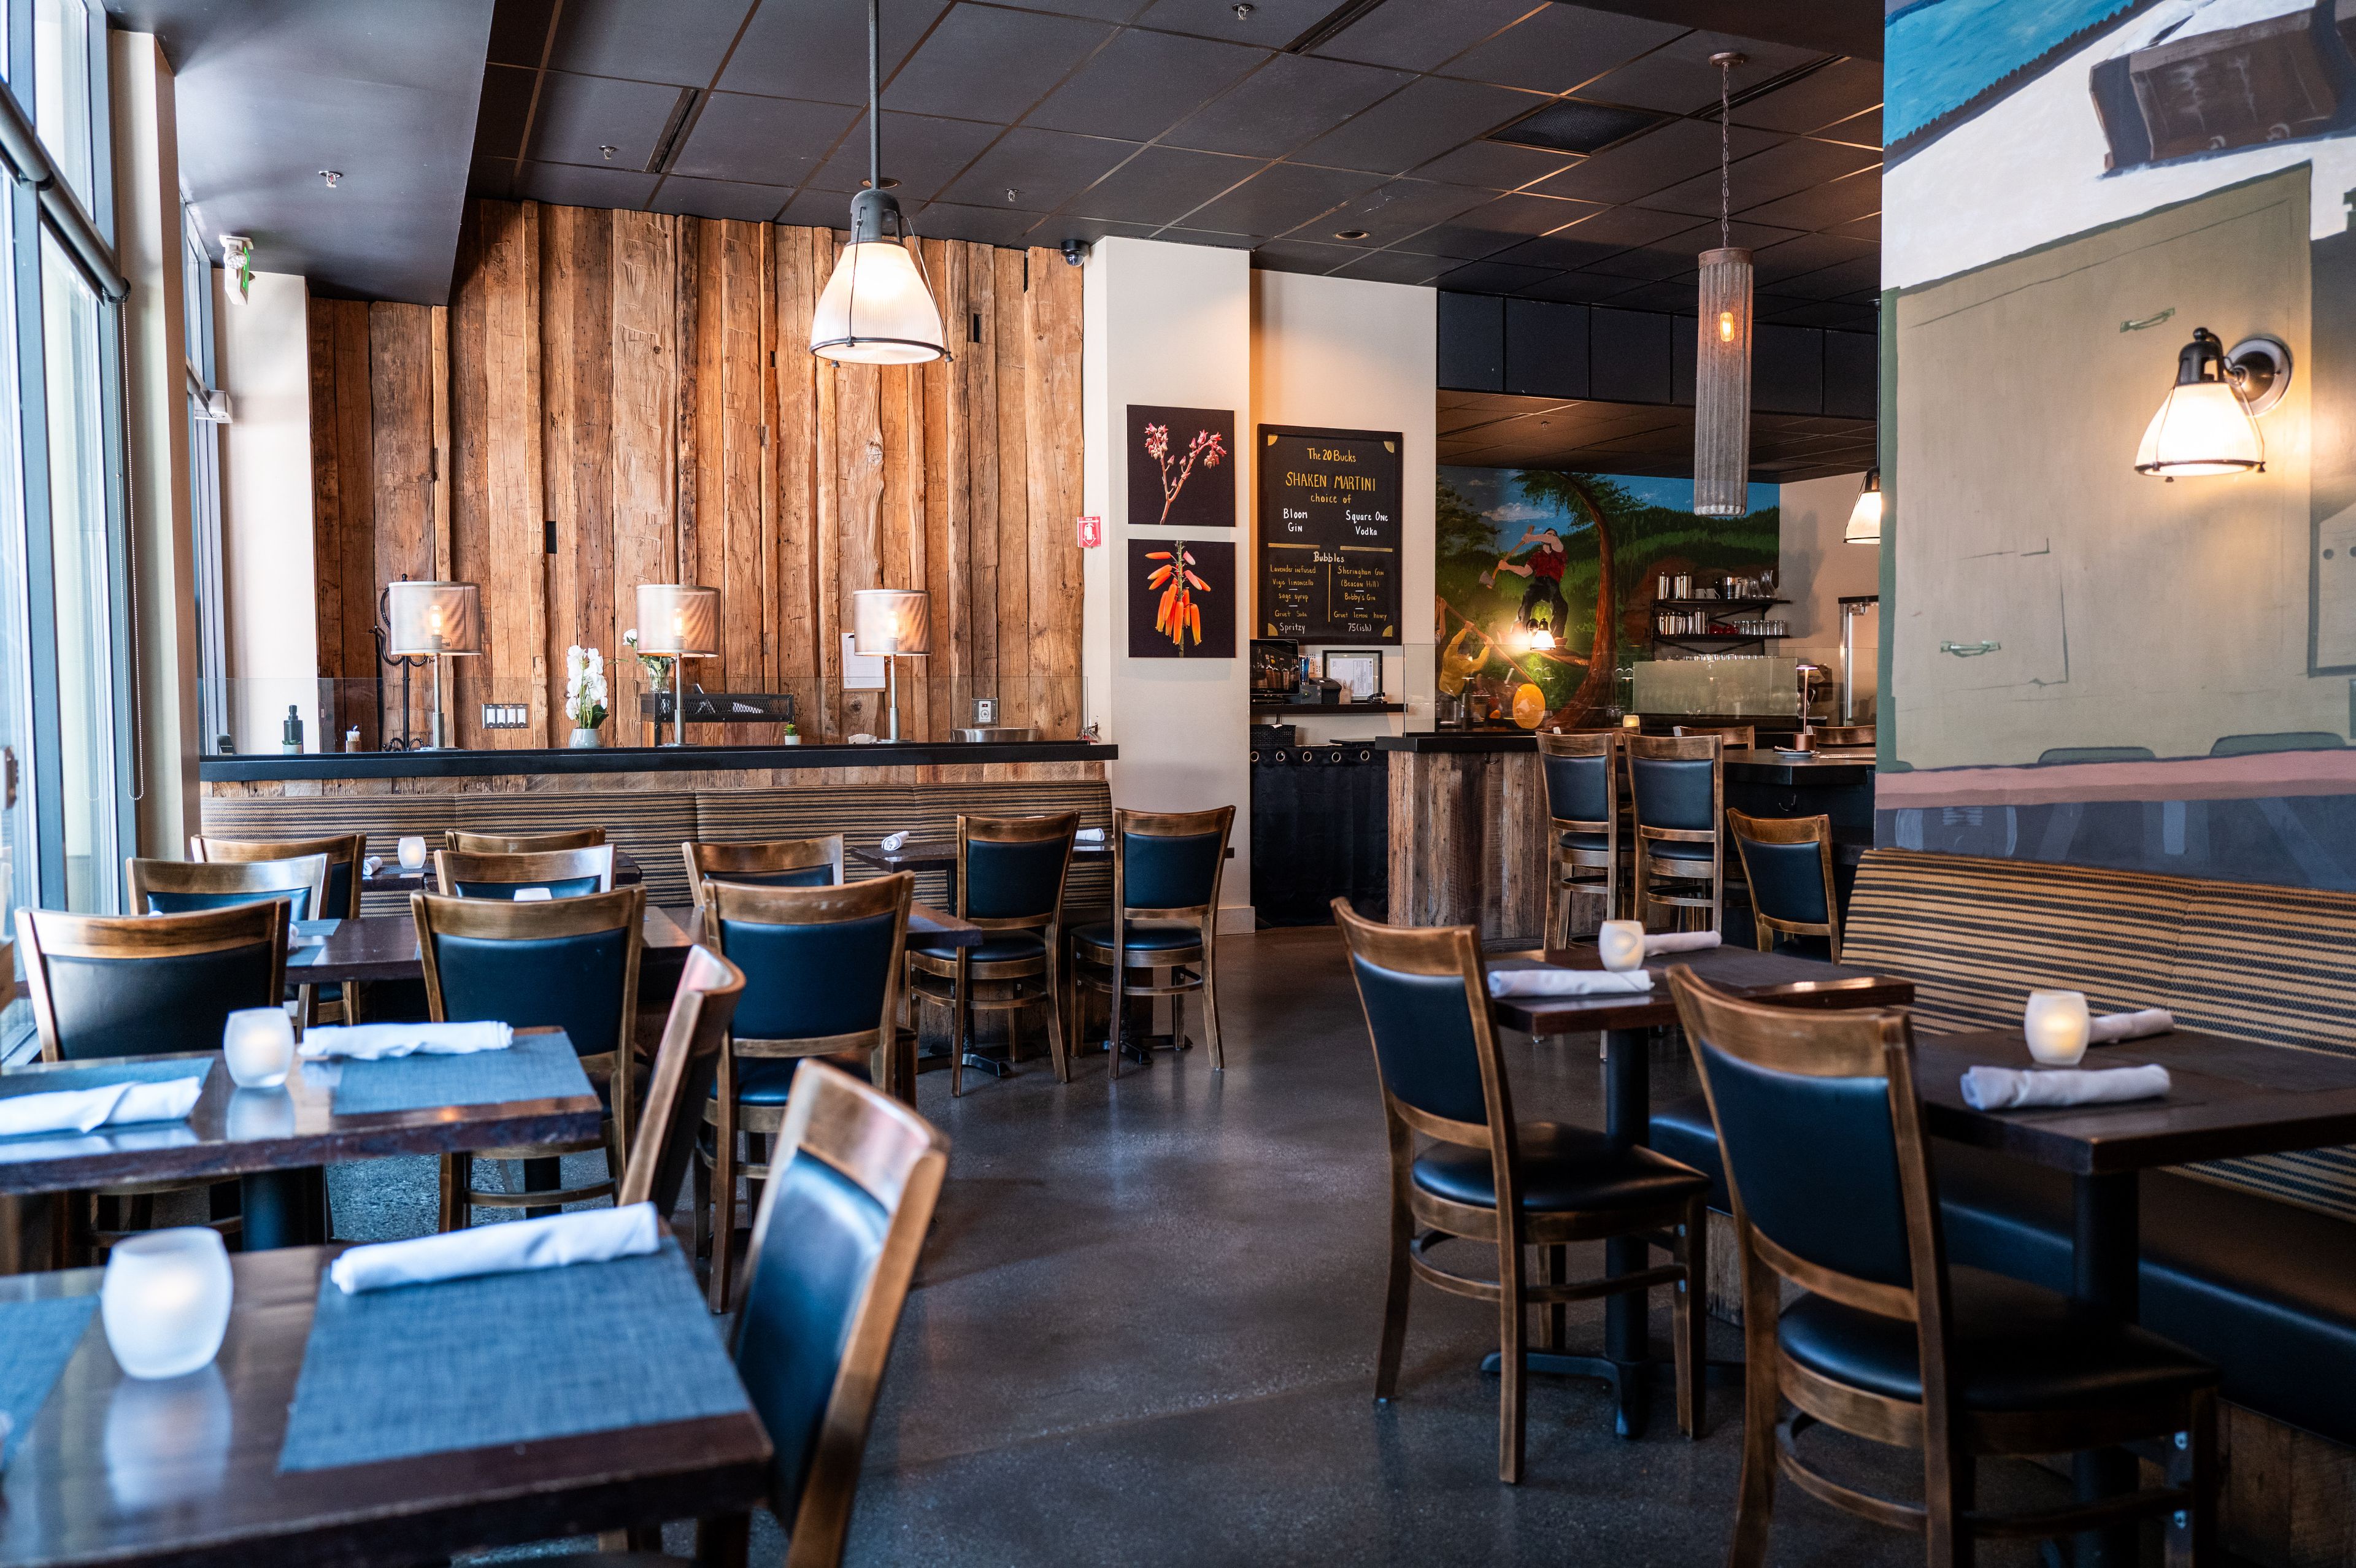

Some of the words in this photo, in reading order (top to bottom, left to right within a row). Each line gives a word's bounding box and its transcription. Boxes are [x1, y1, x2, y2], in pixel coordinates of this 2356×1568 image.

[1307, 448, 1321, 459] The
[1323, 449, 1332, 461] 20
[1334, 450, 1356, 462] Bucks
[1286, 472, 1326, 487] SHAKEN
[1334, 475, 1376, 491] MARTINI
[1311, 493, 1337, 503] choice
[1342, 494, 1351, 504] of
[1284, 509, 1307, 518] Bloom
[1346, 510, 1372, 523] Square
[1355, 526, 1377, 536] Vodka
[1314, 551, 1344, 563] Bubbles
[1295, 565, 1316, 574] infused
[1279, 622, 1306, 634] Spritzy
[1347, 623, 1372, 632] 75(ish)
